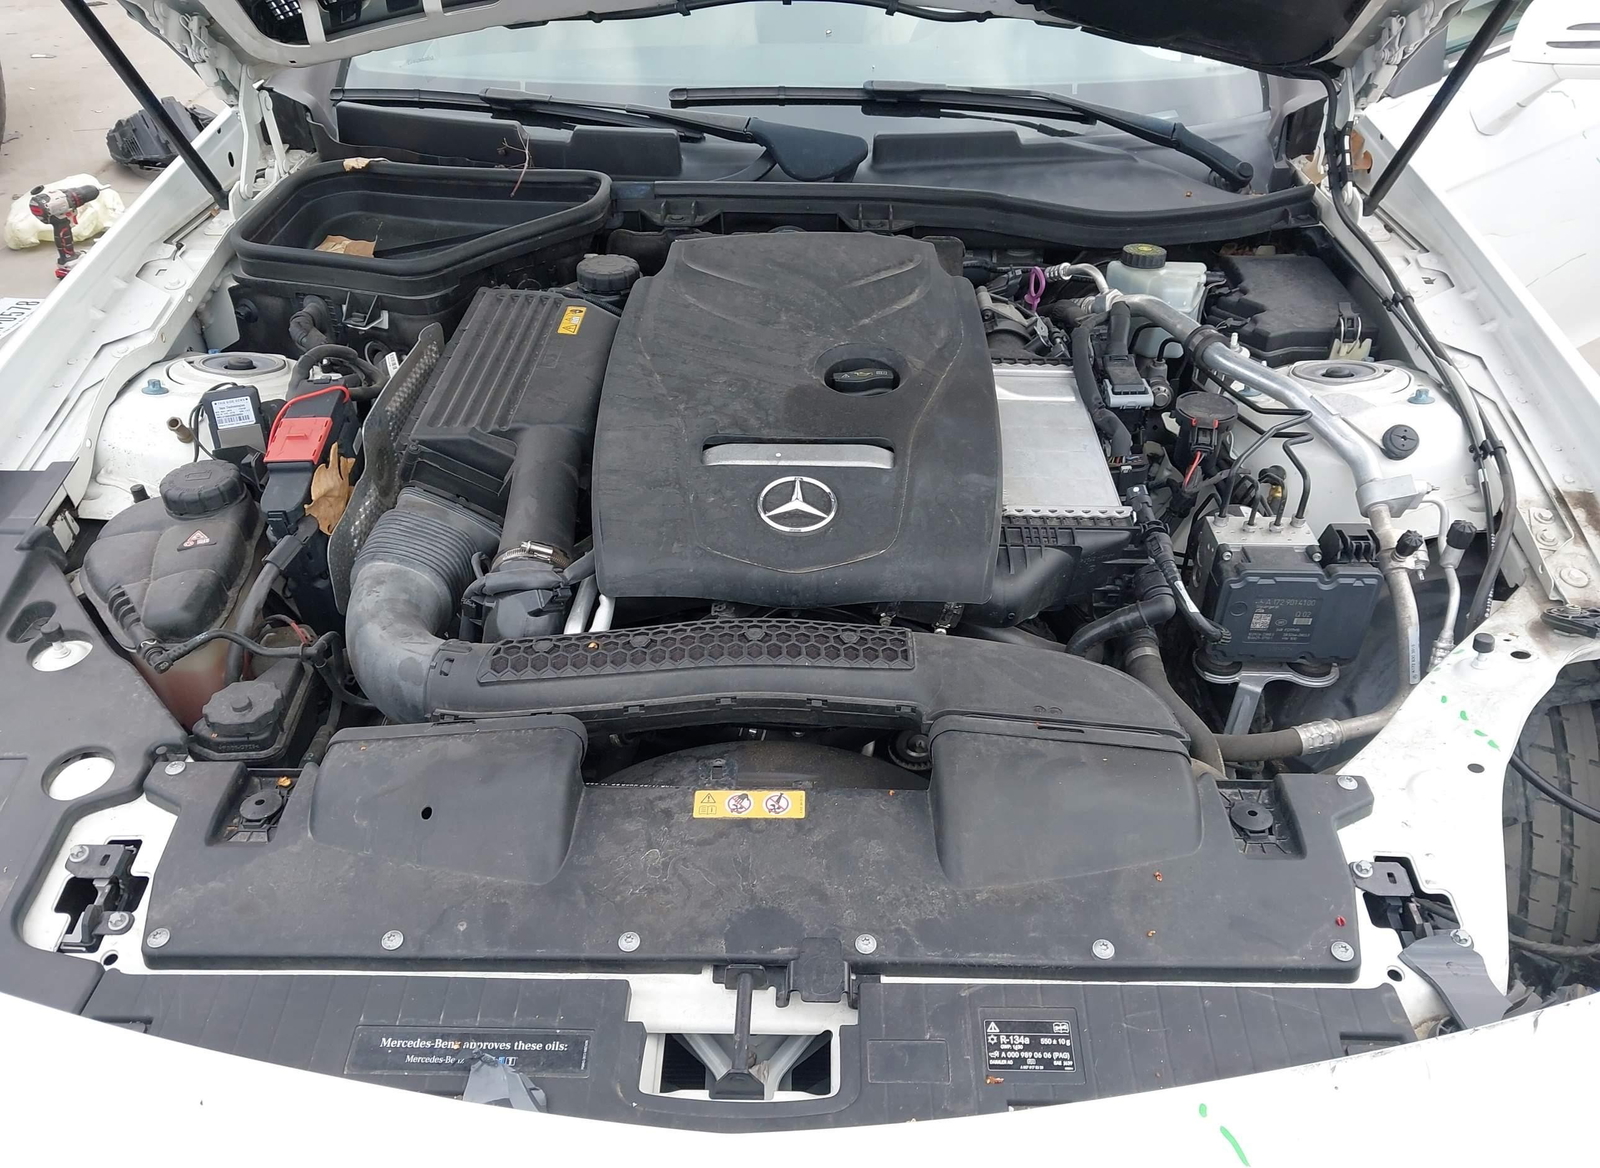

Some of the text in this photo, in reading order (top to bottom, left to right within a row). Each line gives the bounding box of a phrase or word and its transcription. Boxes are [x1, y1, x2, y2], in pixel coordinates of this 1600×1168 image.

[0, 300, 40, 329] 0578
[1000, 1035, 1030, 1044] R-134a
[514, 1040, 544, 1051] these
[545, 1041, 568, 1051] oils:
[405, 1055, 464, 1064] Mercedes-Bez
[1052, 1052, 1070, 1060] (PAG)
